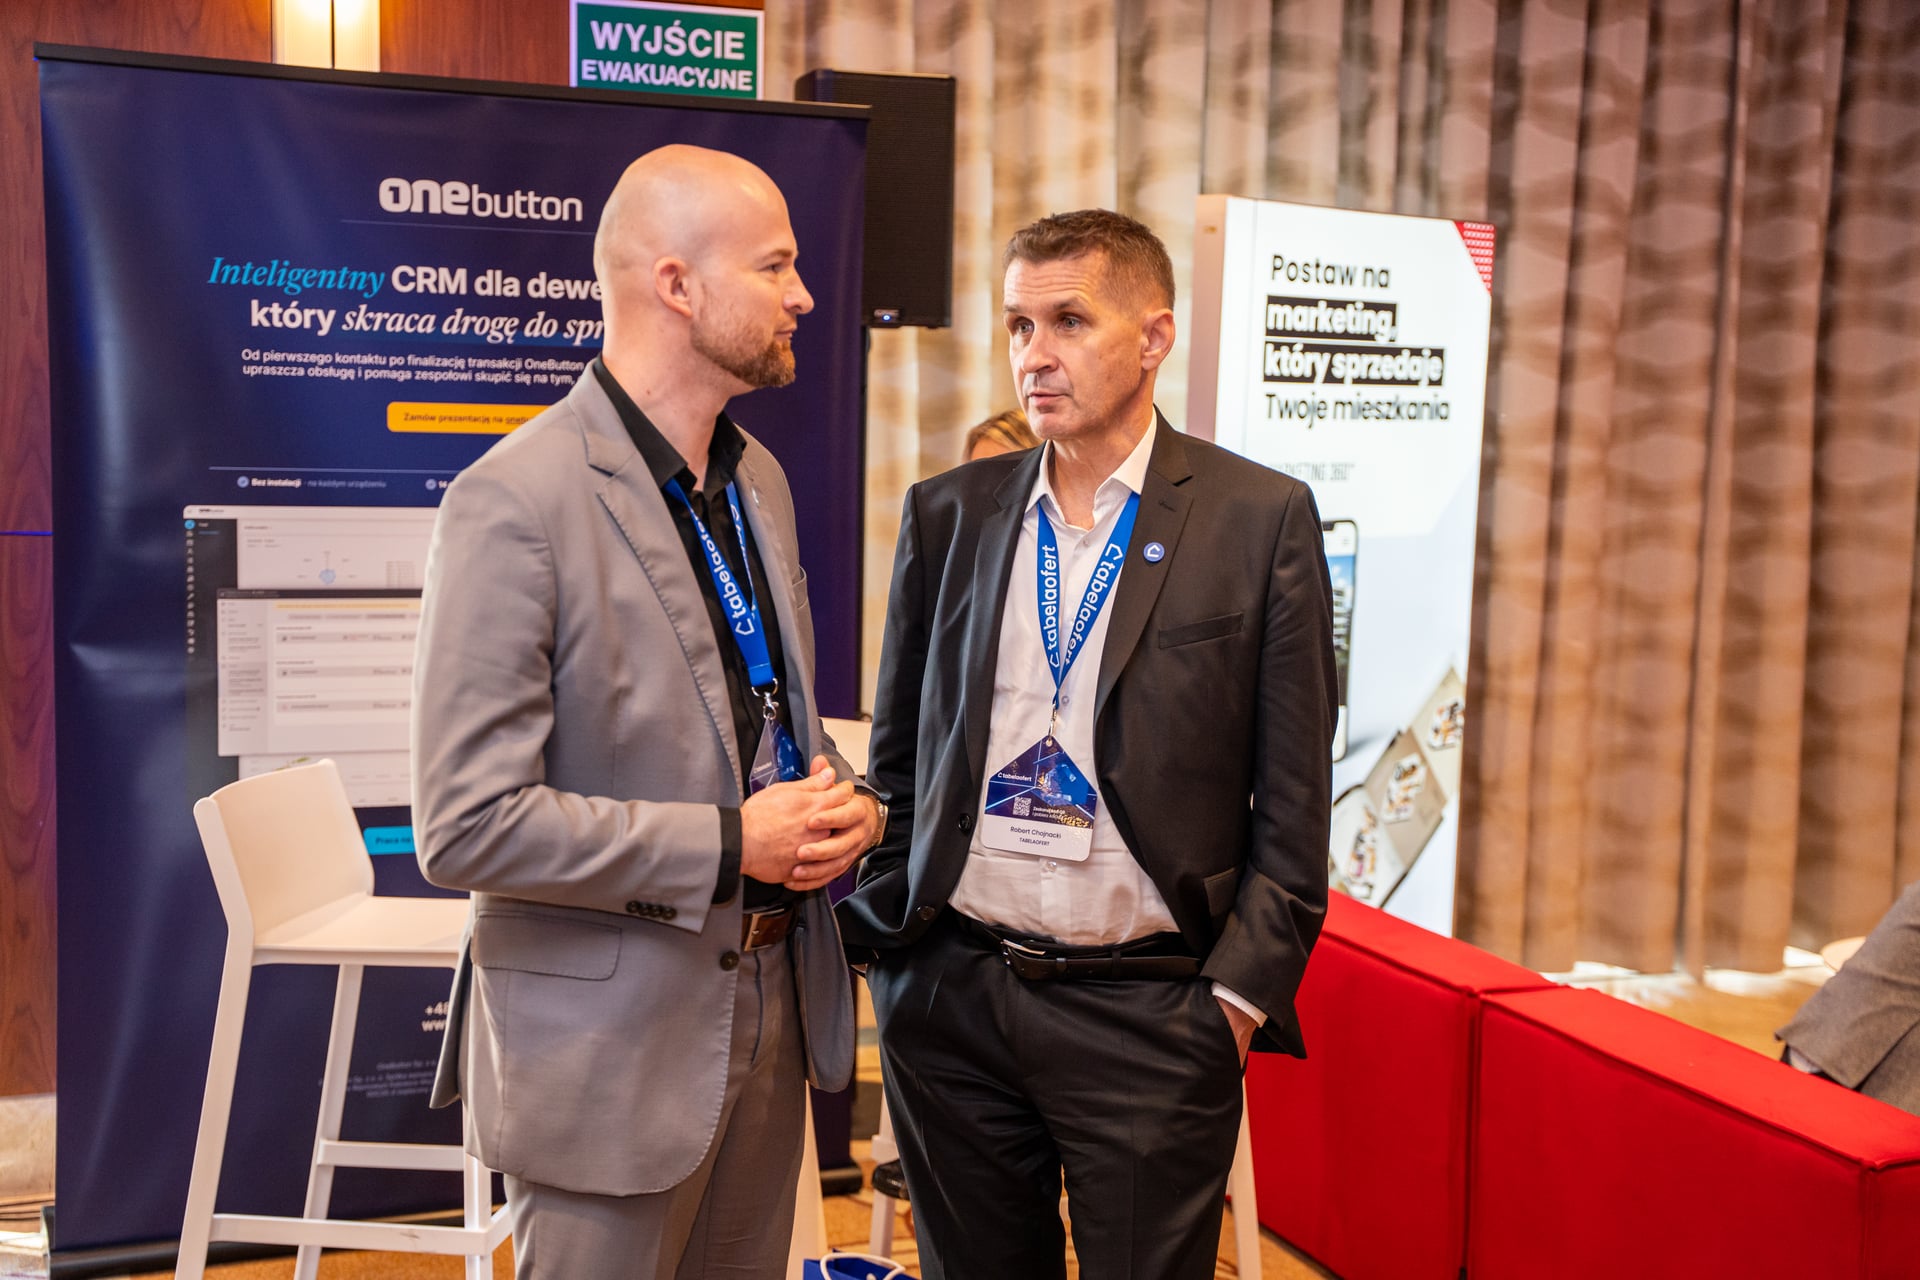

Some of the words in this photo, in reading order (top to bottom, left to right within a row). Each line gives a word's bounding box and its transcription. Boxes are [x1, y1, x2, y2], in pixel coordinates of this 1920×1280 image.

[590, 20, 745, 60] WYJŚCIE
[581, 59, 753, 91] EWAKUACYJNE
[207, 256, 386, 299] Inteligentny
[391, 265, 468, 296] CRM
[474, 269, 521, 299] dla
[1272, 254, 1357, 286] Postaw
[1362, 266, 1391, 288] na
[250, 299, 336, 337] który
[341, 304, 435, 336] skraca
[442, 307, 518, 344] drogę
[524, 311, 559, 339] do
[241, 348, 261, 362] Od
[263, 351, 333, 365] pierwszego
[336, 353, 387, 365] kontaktu
[389, 355, 405, 368] po
[407, 354, 466, 370] finalizację
[467, 357, 523, 371] transakcji
[524, 358, 585, 372] OneButton
[242, 365, 304, 377] upraszcza
[308, 367, 355, 380] obsługę
[358, 367, 362, 378] i
[364, 368, 412, 382] pomaga
[414, 369, 473, 383] zespołowi
[474, 371, 512, 384] skupić
[514, 372, 531, 386] się
[533, 374, 549, 384] na
[1264, 343, 1331, 385] który
[1331, 348, 1444, 388] sprzedaje
[1265, 391, 1328, 429] Twoje
[1332, 392, 1450, 420] mieszkania
[251, 478, 266, 487] Bez
[266, 478, 302, 489] instalacji
[1011, 827, 1030, 835] Robert
[1031, 830, 1061, 839] Chojnacki
